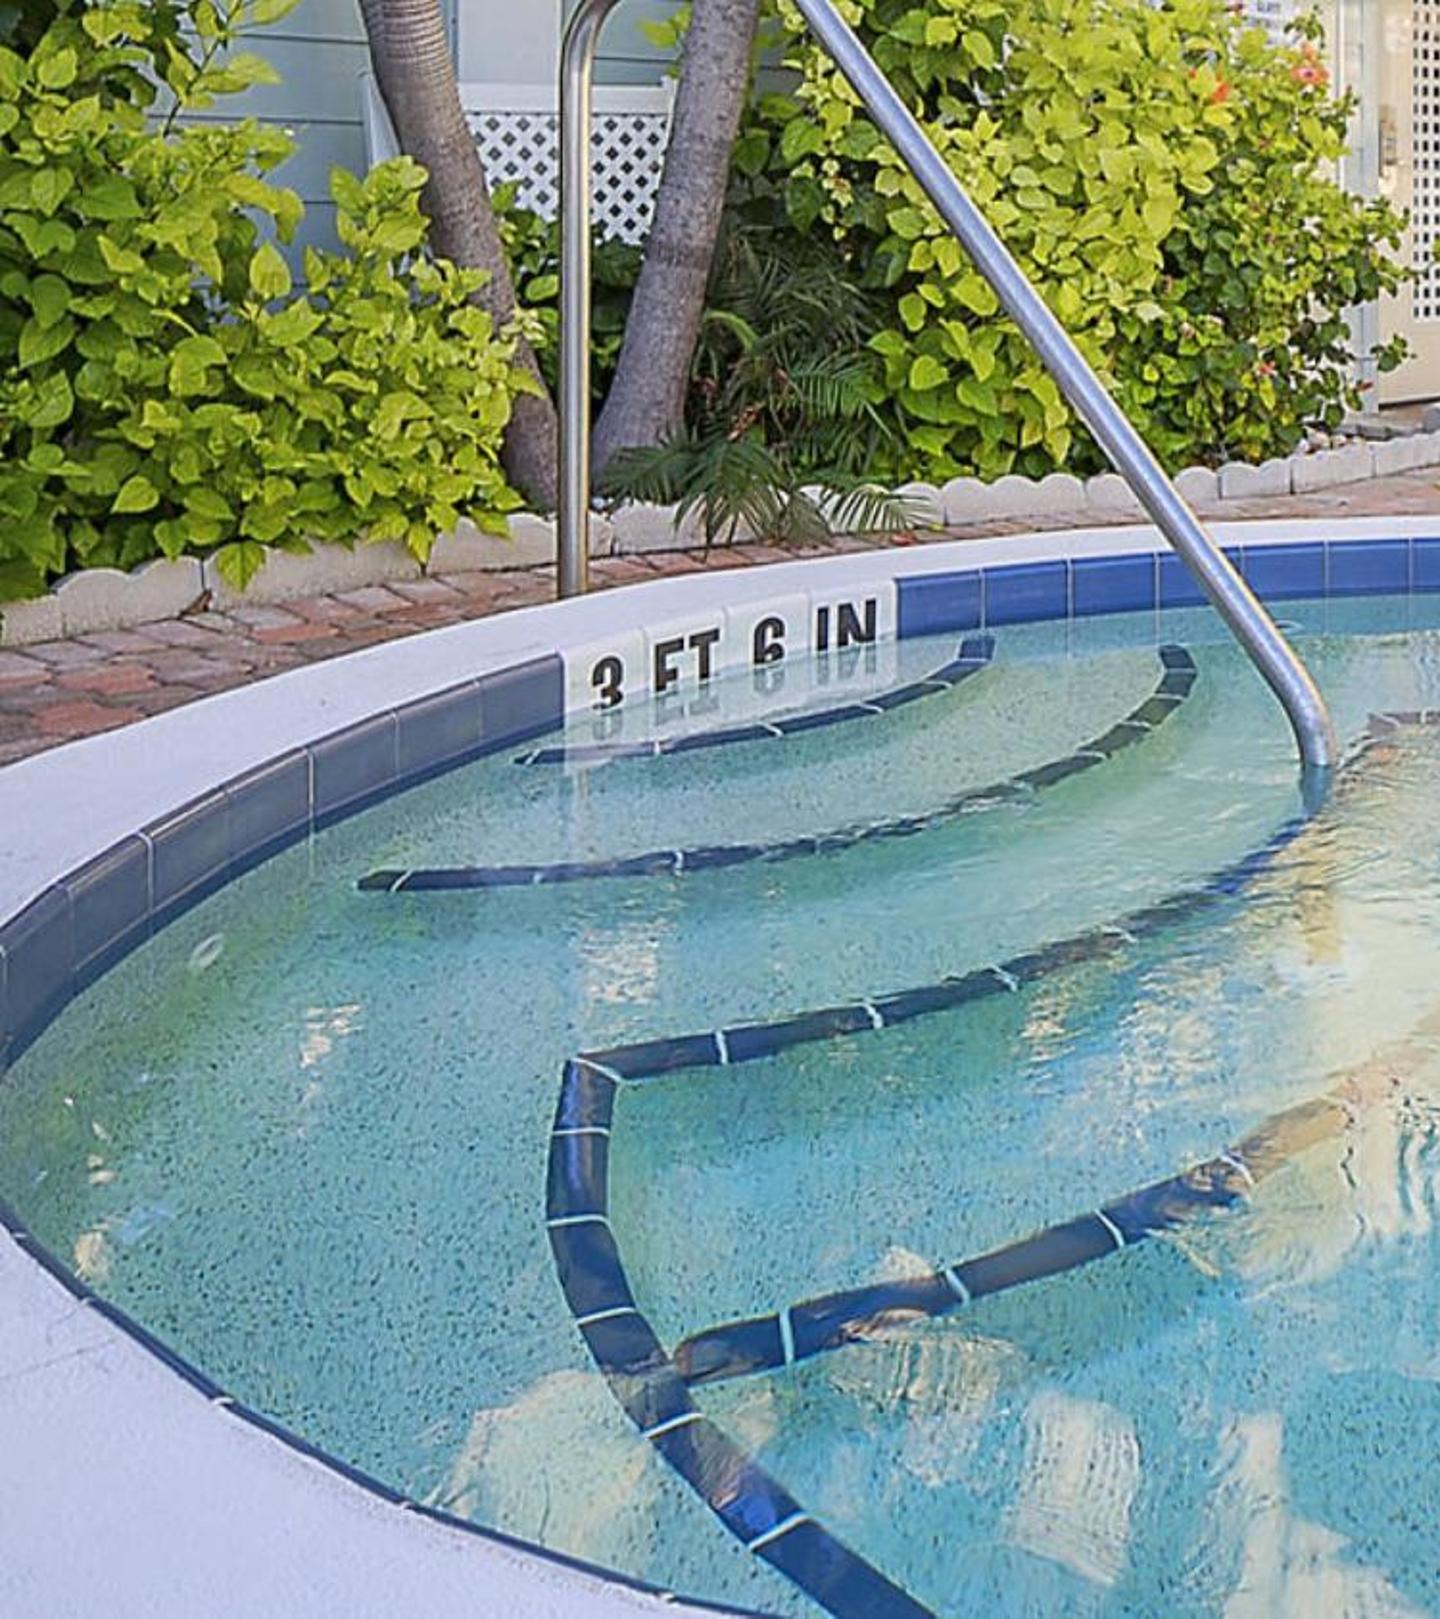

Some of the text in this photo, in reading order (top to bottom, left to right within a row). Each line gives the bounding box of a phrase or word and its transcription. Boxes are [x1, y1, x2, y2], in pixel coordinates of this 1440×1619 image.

[592, 599, 877, 710] 3 FT 6 IN
